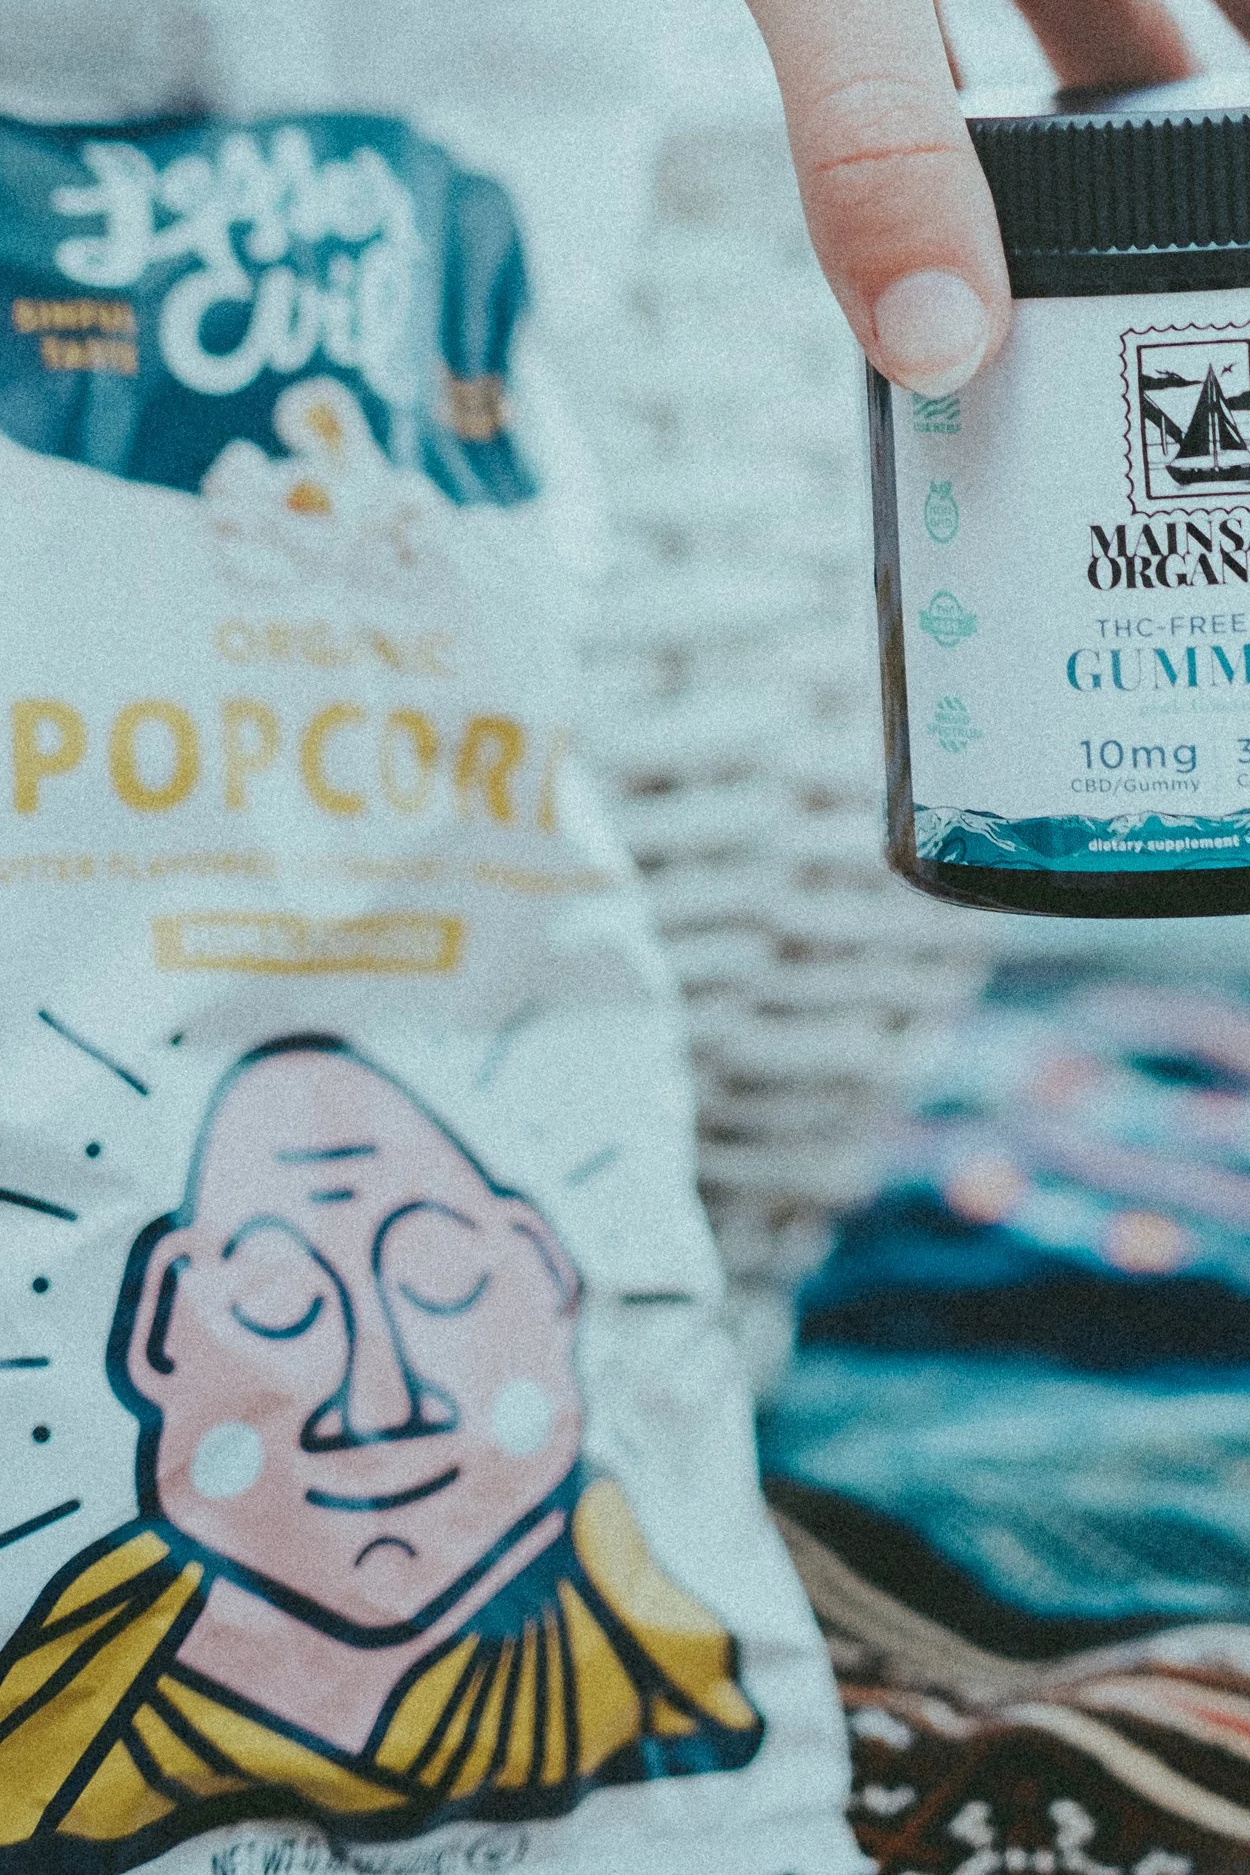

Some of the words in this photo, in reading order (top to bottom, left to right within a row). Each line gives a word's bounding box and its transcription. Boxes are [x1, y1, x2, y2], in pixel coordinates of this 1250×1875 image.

[1096, 612, 1248, 638] THC-FREE
[1080, 738, 1197, 774] 10mg
[1071, 777, 1200, 796] CBD/Gummy
[1088, 838, 1144, 854] dietary
[1149, 834, 1240, 853] supplement
